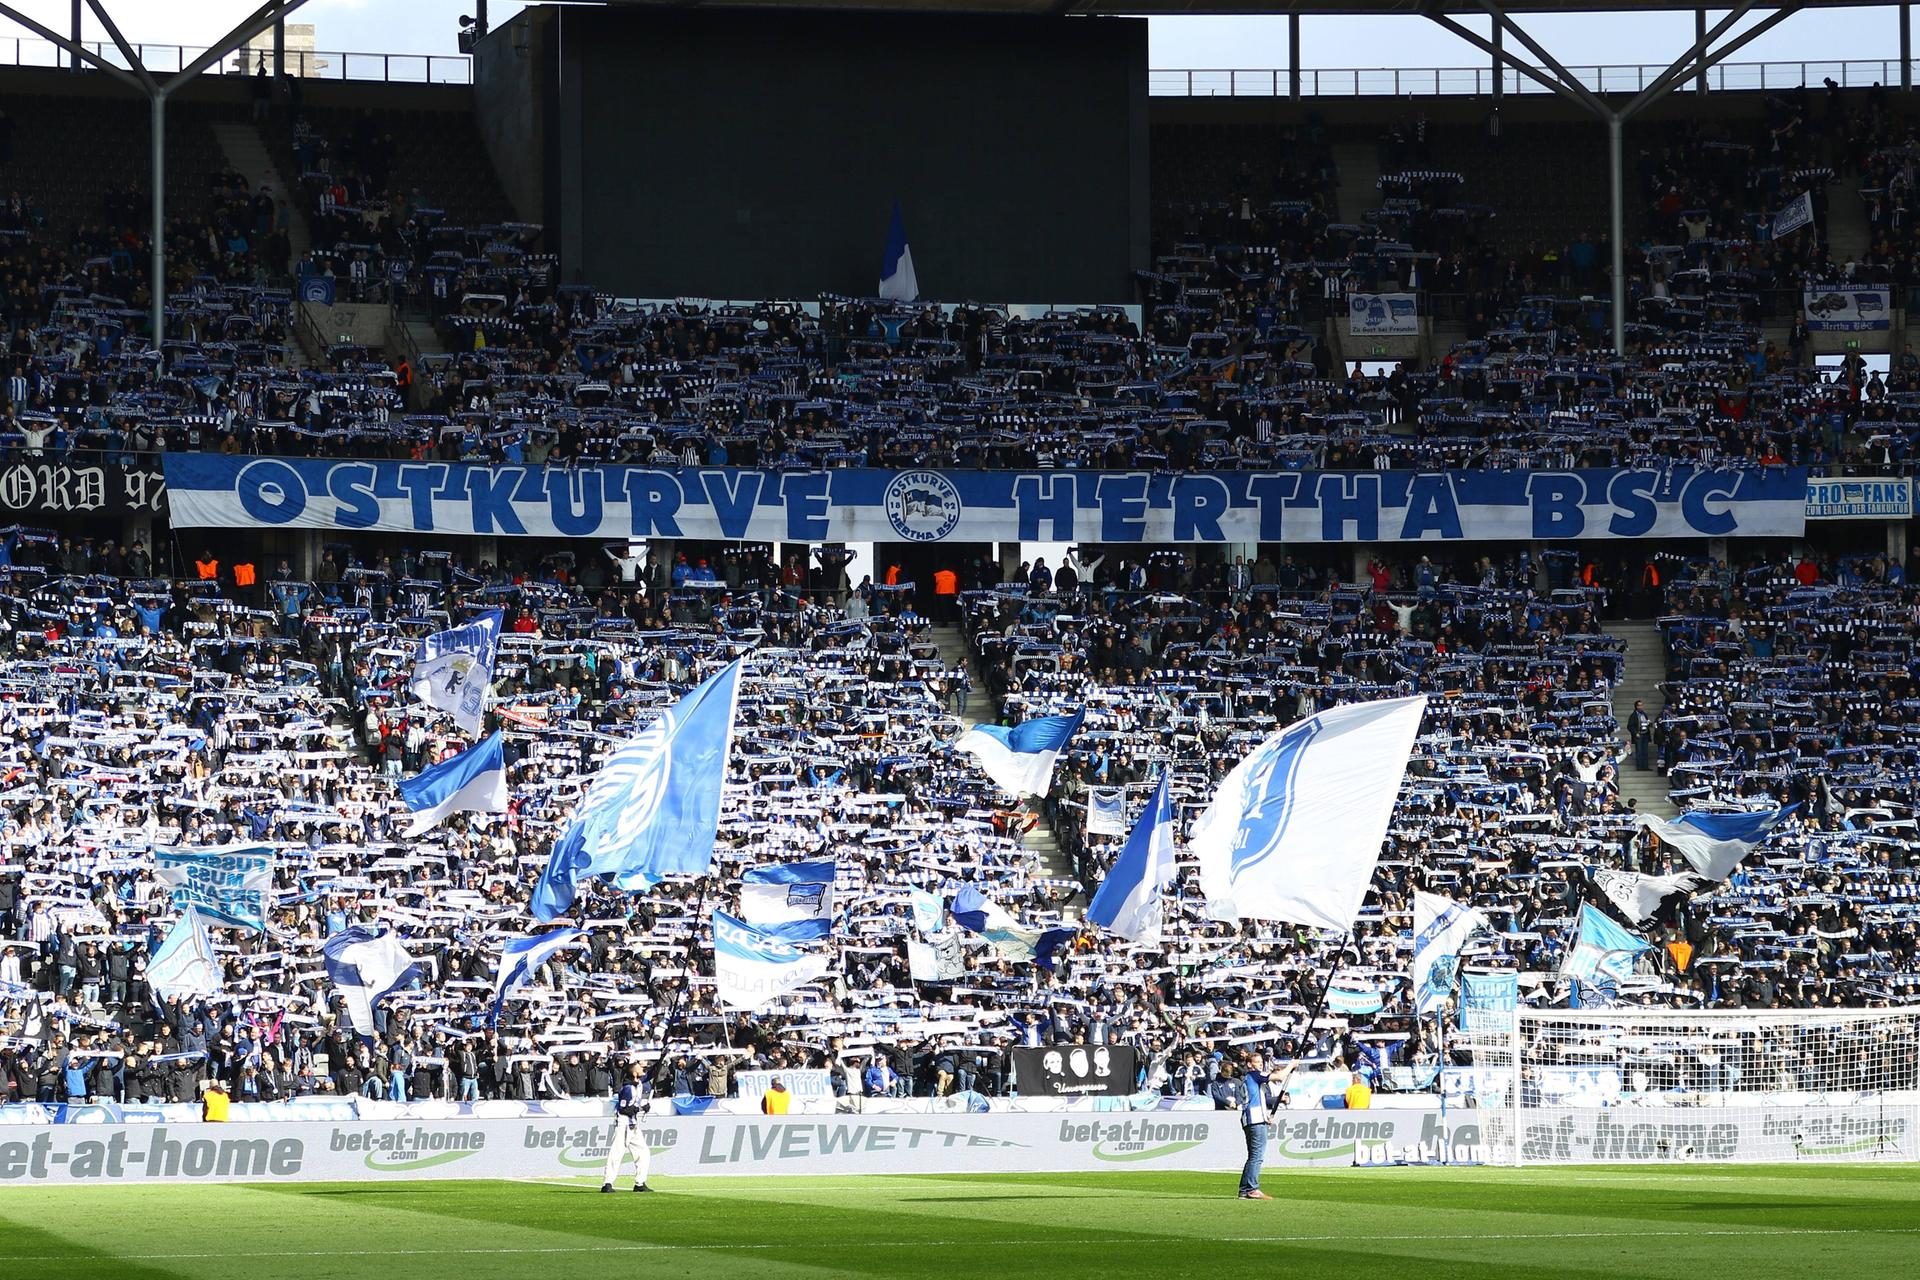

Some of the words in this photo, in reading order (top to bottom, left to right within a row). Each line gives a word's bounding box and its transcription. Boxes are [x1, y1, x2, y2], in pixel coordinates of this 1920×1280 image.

[892, 474, 952, 498] OSTKURVE
[1808, 485, 1841, 504] PRO
[1864, 484, 1907, 502] FANS
[235, 459, 832, 540] OSTKURVE
[944, 502, 956, 510] 92
[1012, 472, 1464, 541] HERTHA
[1525, 470, 1744, 538] BSC
[1852, 504, 1866, 514] DER
[891, 512, 934, 540] HERTHA
[936, 514, 956, 536] BSC
[745, 1072, 825, 1096] RAAZZI
[330, 1126, 486, 1150] bet-at-home
[1059, 1118, 1209, 1142] bet-at-home
[386, 1149, 418, 1160] .com
[1114, 1140, 1144, 1151] .com
[1300, 1139, 1330, 1149] .com
